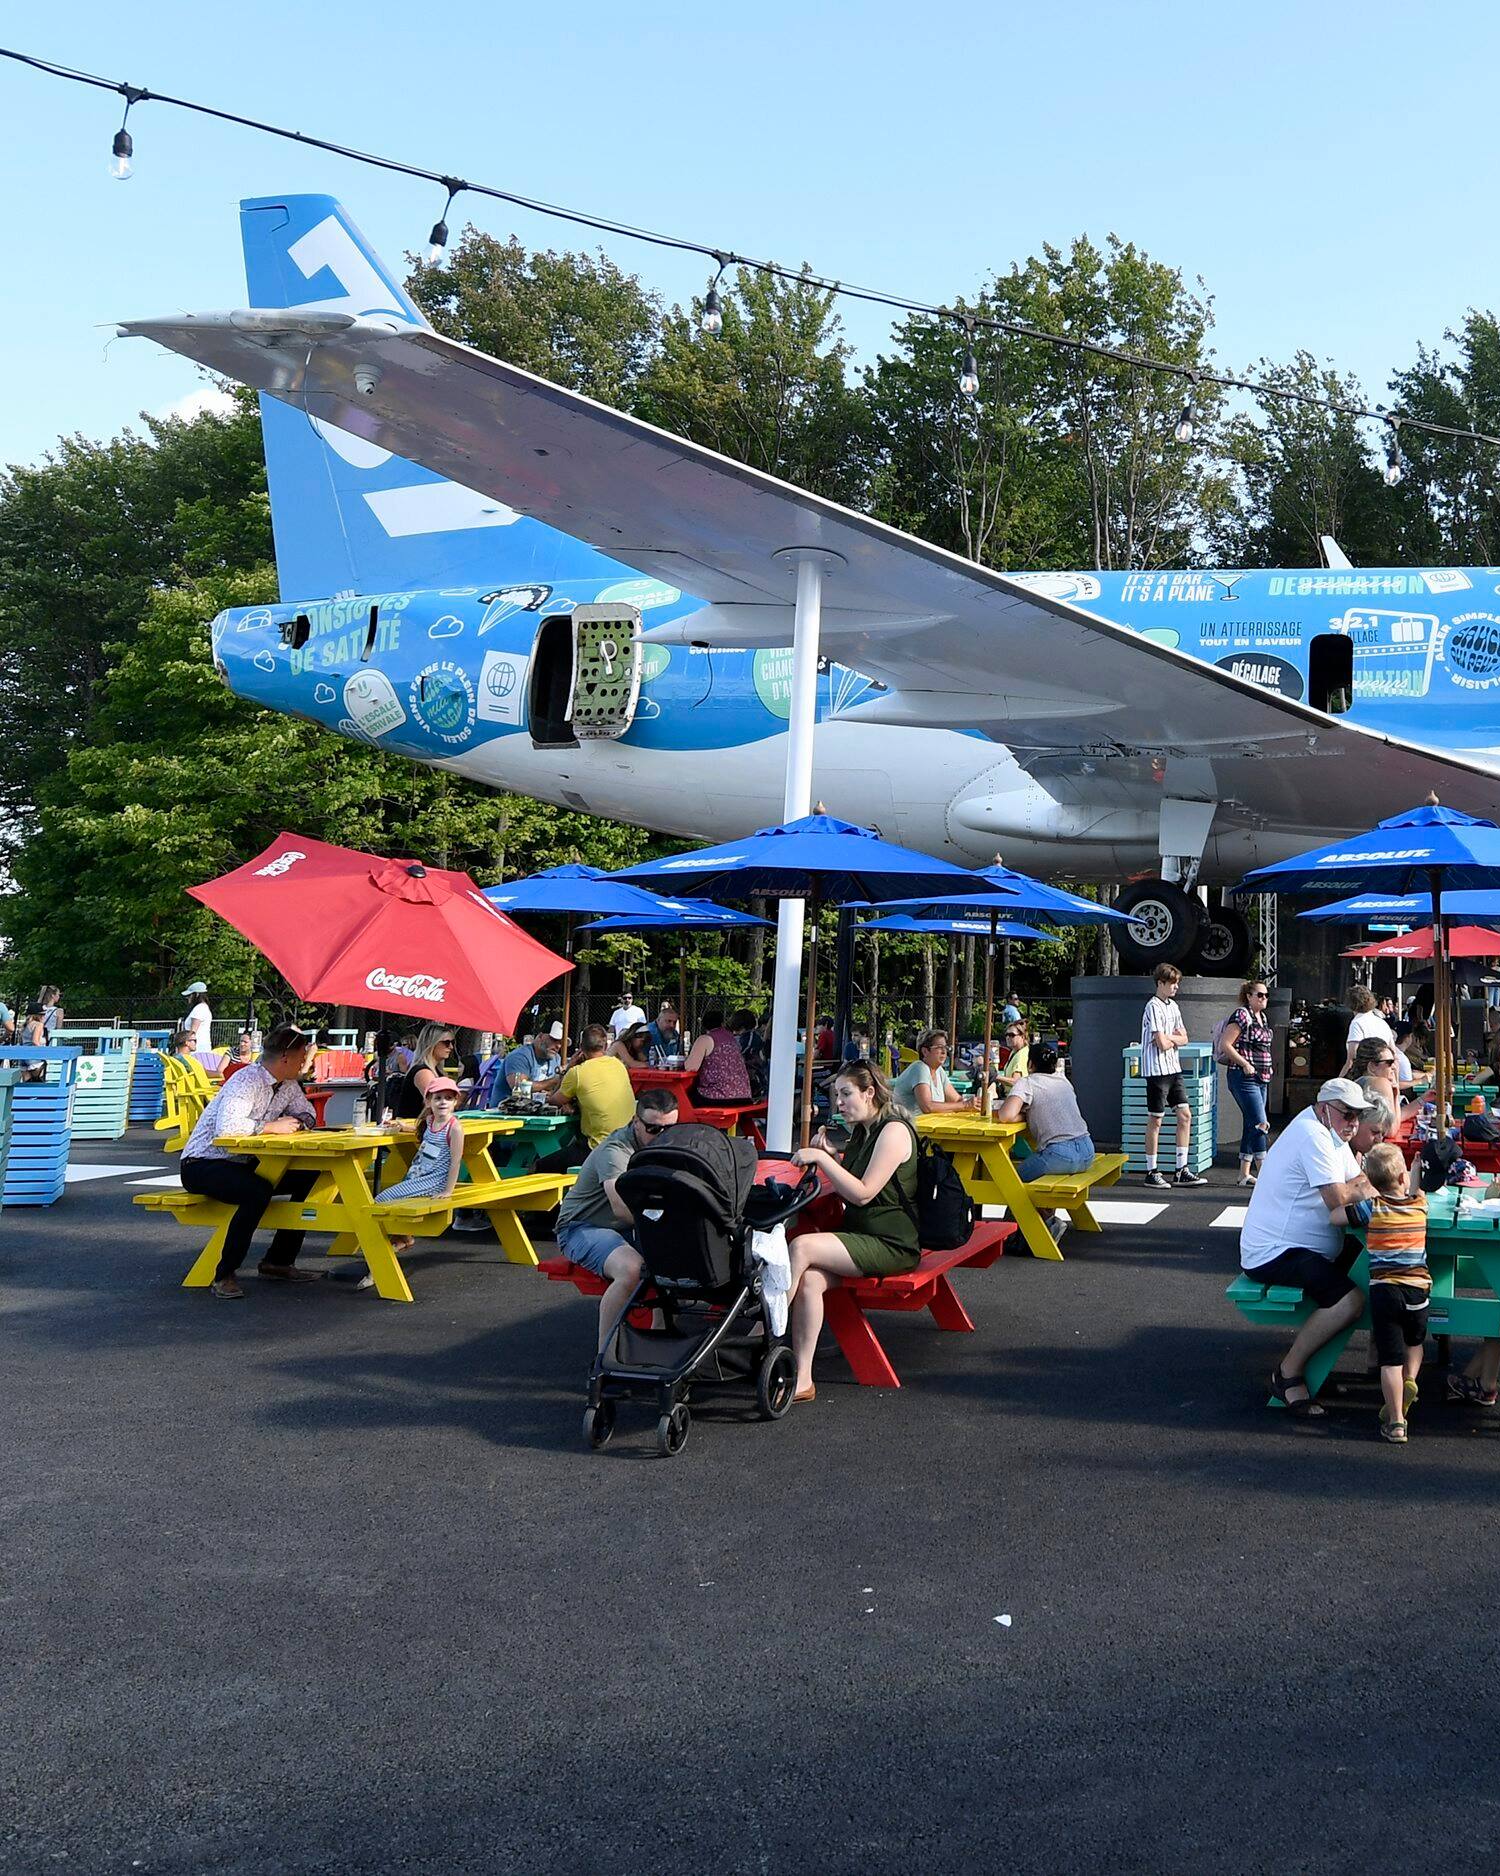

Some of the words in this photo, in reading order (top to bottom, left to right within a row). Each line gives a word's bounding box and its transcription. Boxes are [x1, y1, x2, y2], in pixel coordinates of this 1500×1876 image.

[1126, 574, 1154, 586] IT'S
[1158, 574, 1168, 586] A
[1172, 574, 1203, 586] BAR
[1121, 585, 1151, 602] IT'S
[1153, 585, 1164, 602] A
[1168, 585, 1215, 602] PLANE
[1200, 622, 1216, 637] UN
[1221, 621, 1302, 637] ATTERRISSAGE
[1199, 638, 1229, 647] TOUT
[1234, 638, 1250, 646] EN
[1255, 638, 1302, 646] SAVEUR
[441, 661, 455, 672] LE
[1231, 659, 1282, 685] DÉCALAGE
[454, 666, 476, 704] PLEIN
[408, 695, 431, 733] VIENS
[440, 726, 472, 744] SOLEIL
